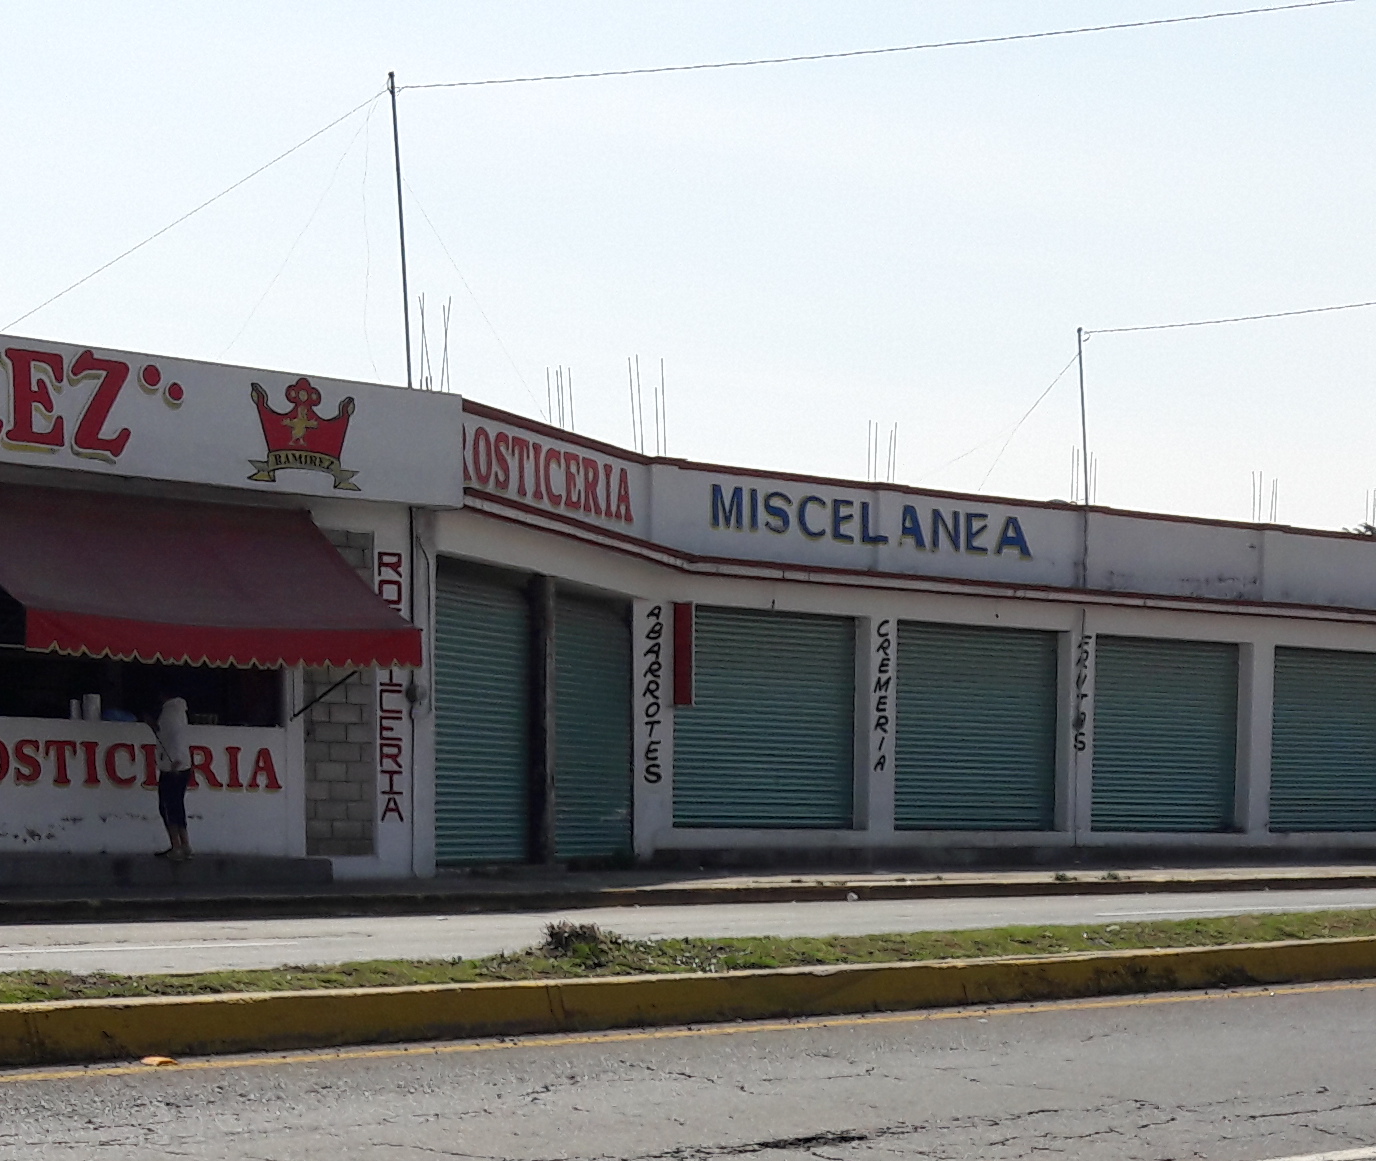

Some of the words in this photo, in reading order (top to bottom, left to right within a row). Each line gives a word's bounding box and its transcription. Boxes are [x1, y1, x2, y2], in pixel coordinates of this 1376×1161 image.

[273, 452, 335, 470] RAMIREZ
[711, 483, 1032, 558] MISCELANEA
[377, 552, 404, 822] ROICERIA
[642, 605, 663, 784] ABARROTES
[873, 618, 892, 772] CREMERIA
